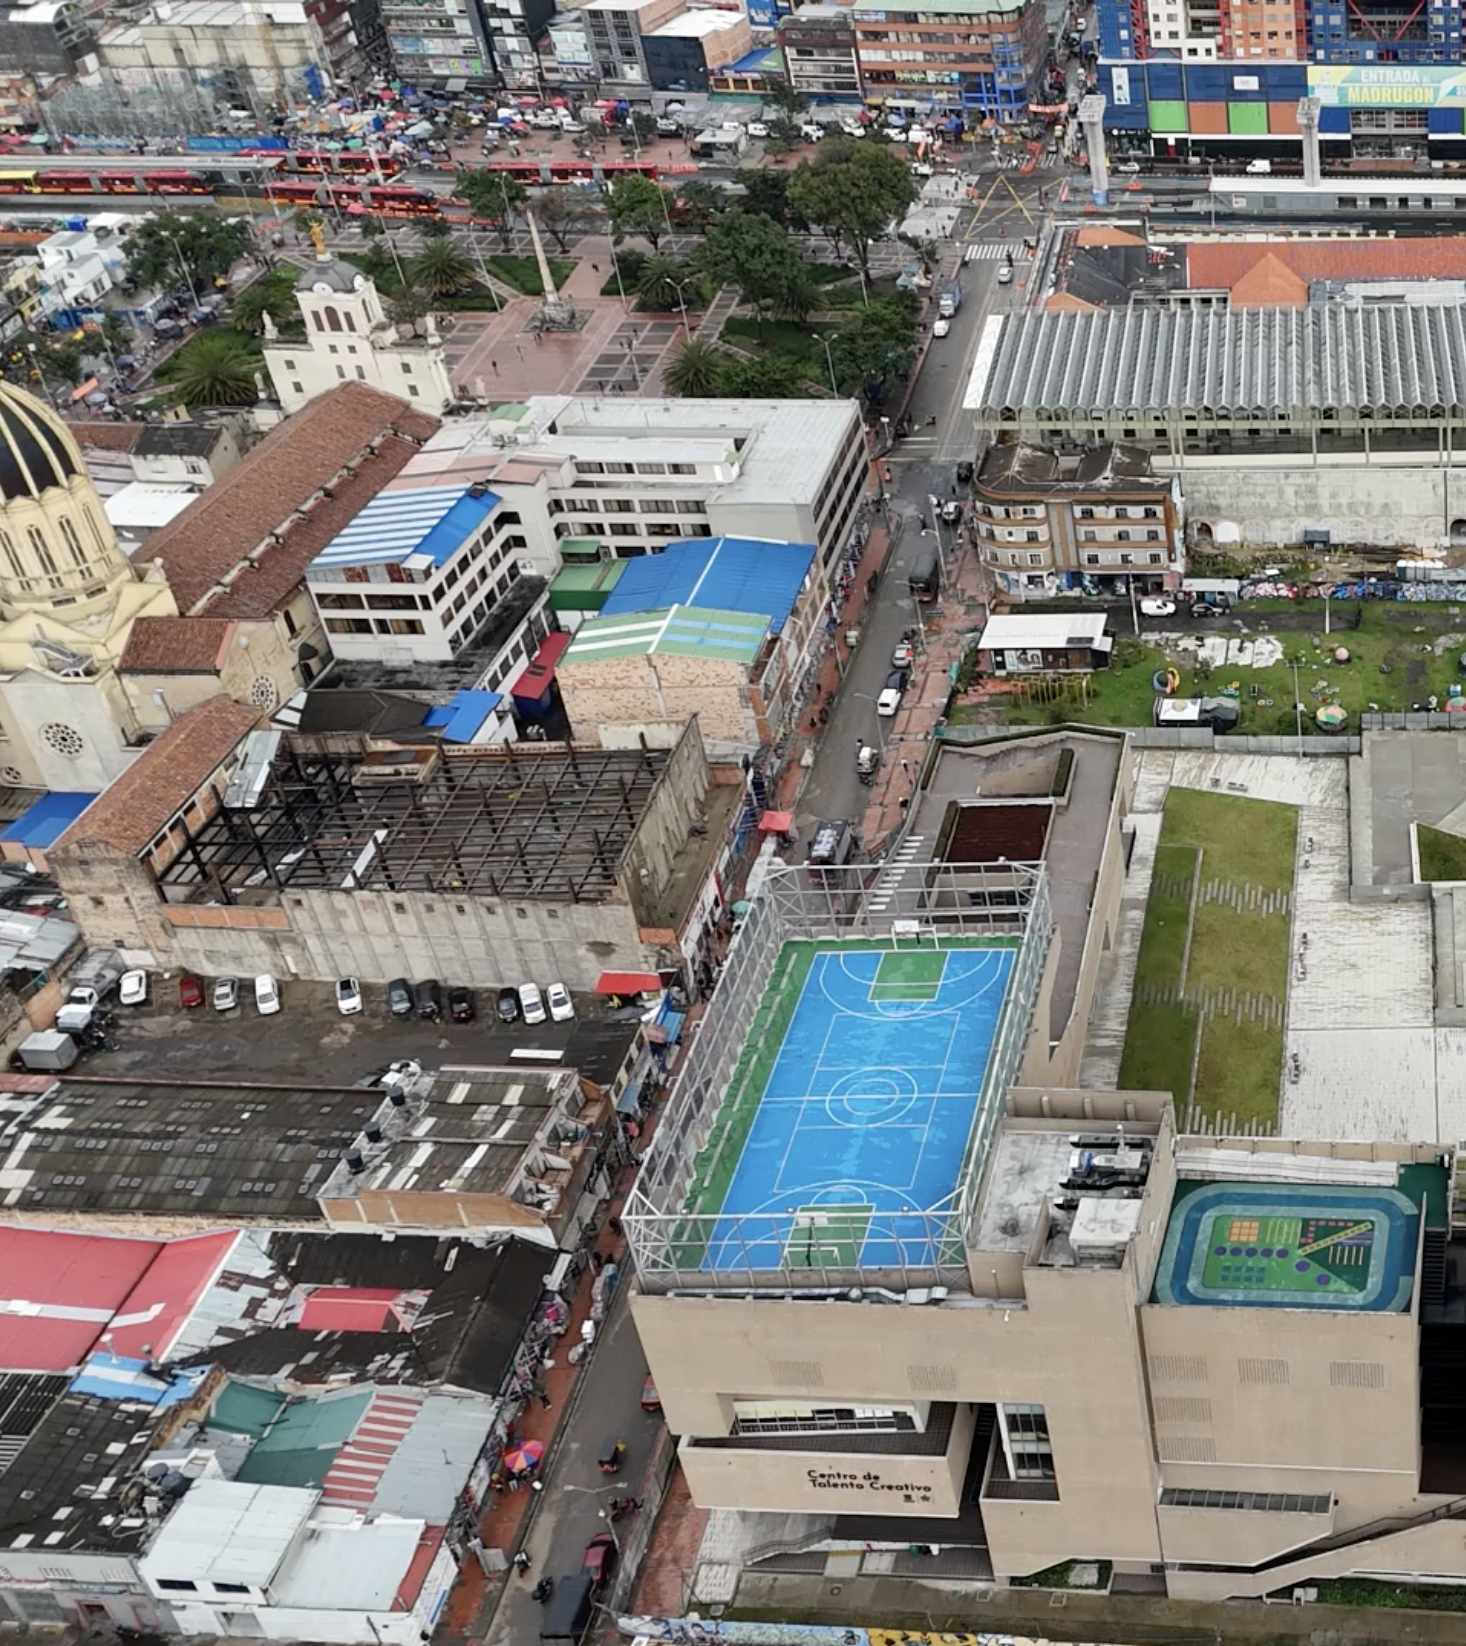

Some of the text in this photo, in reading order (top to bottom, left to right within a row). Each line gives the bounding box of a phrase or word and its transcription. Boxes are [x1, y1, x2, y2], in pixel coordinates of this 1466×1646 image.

[1361, 69, 1420, 83] ENTRADA
[807, 1470, 880, 1481] Centro de
[810, 1479, 932, 1492] Talento Creativo
